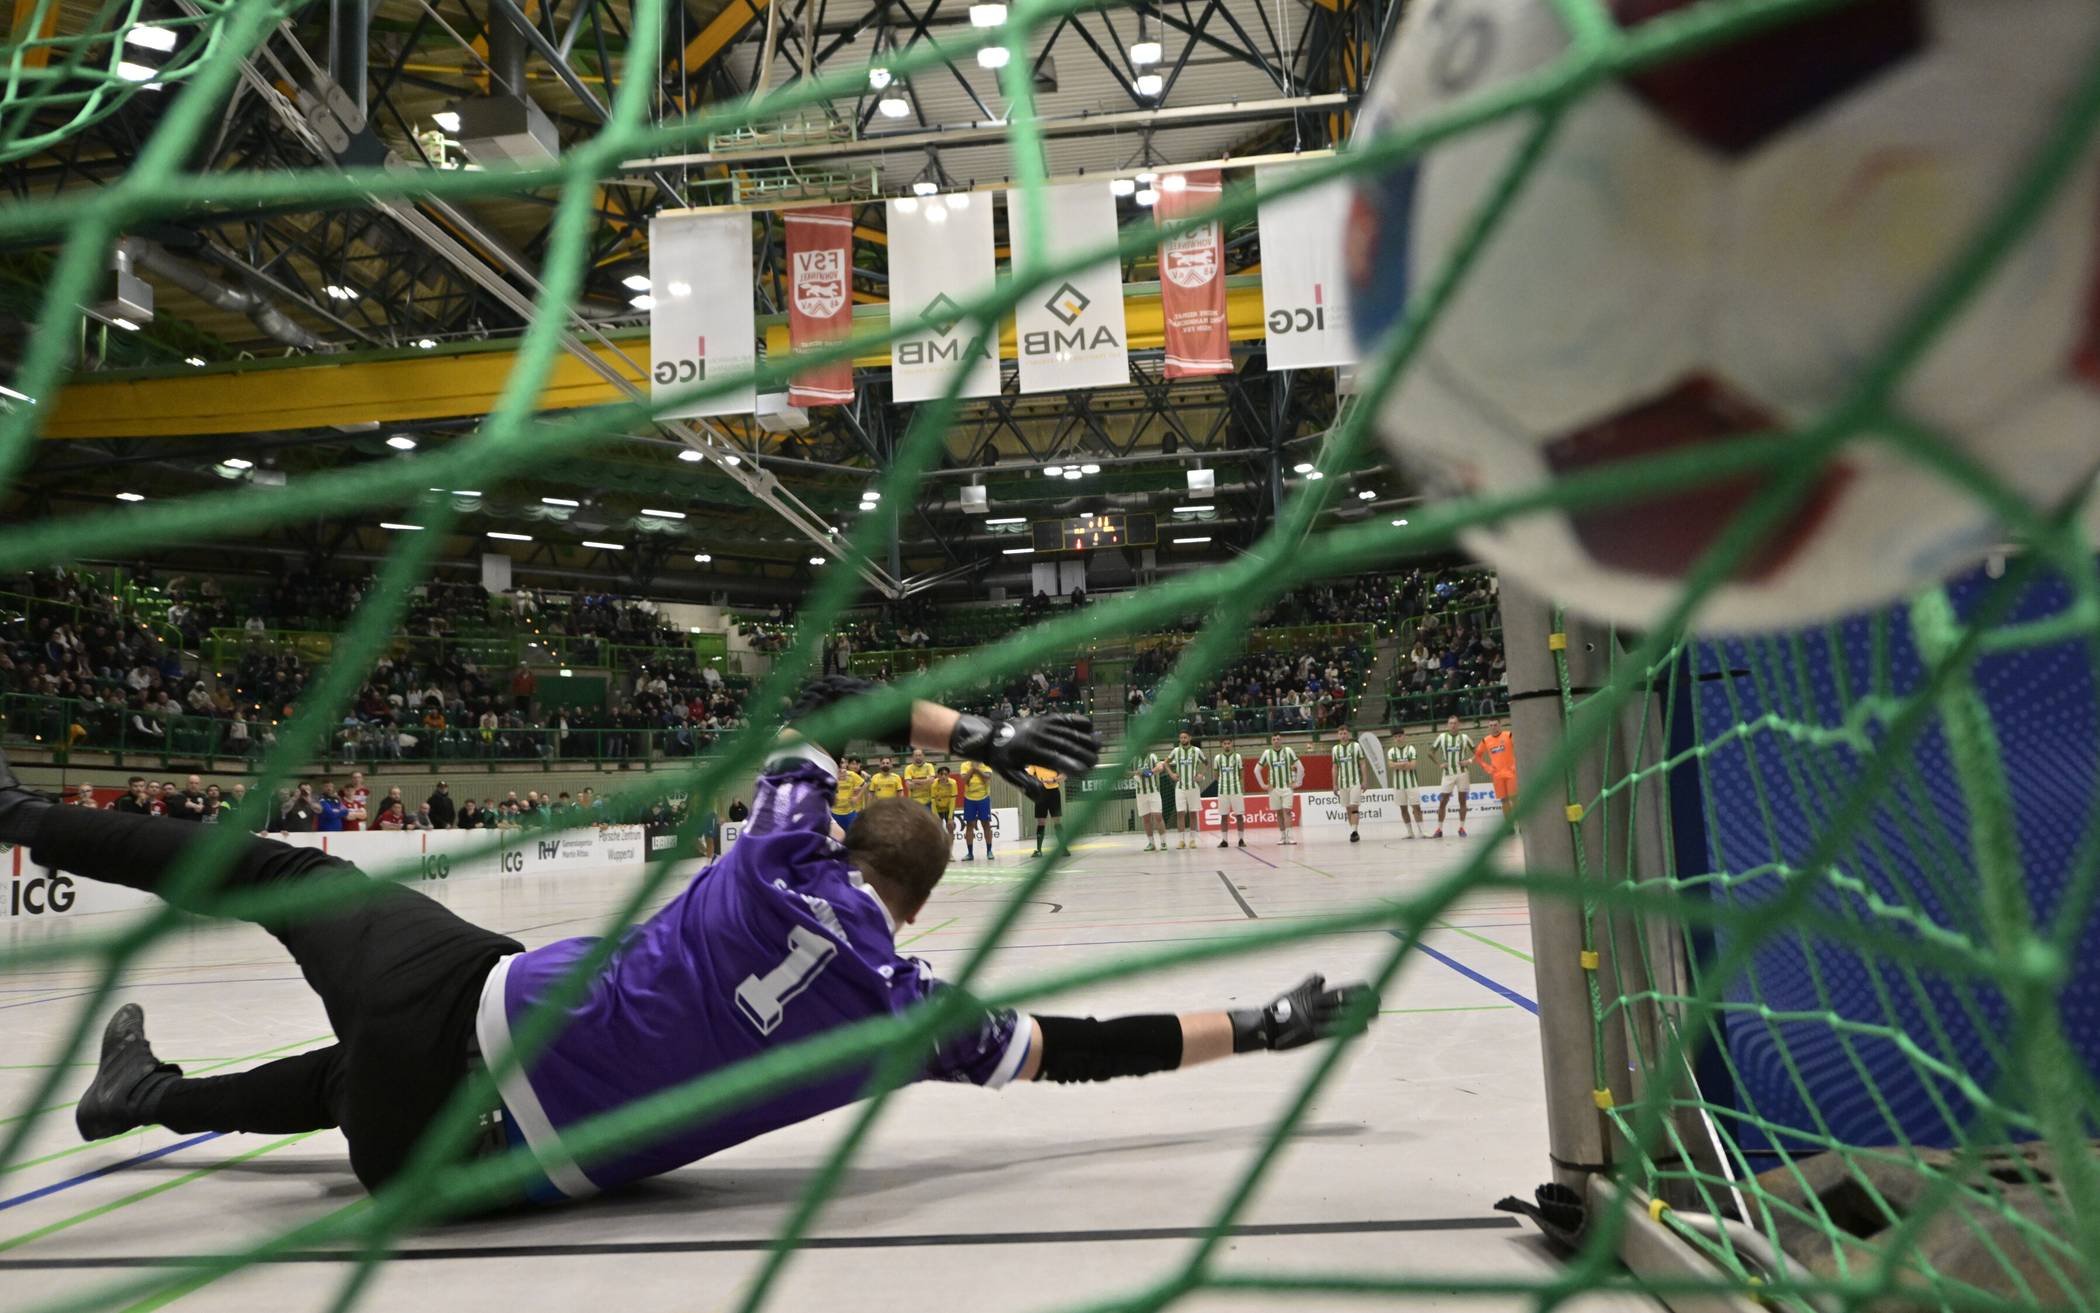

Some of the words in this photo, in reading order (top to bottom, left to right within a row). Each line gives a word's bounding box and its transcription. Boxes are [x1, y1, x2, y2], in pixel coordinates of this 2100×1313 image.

[1360, 793, 1394, 803] entrum
[1326, 808, 1382, 821] Wupertal
[538, 840, 560, 860] R+V
[422, 854, 450, 880] ICG
[501, 851, 523, 873] ICG
[11, 876, 76, 916] ICG
[735, 925, 838, 1037] 1
